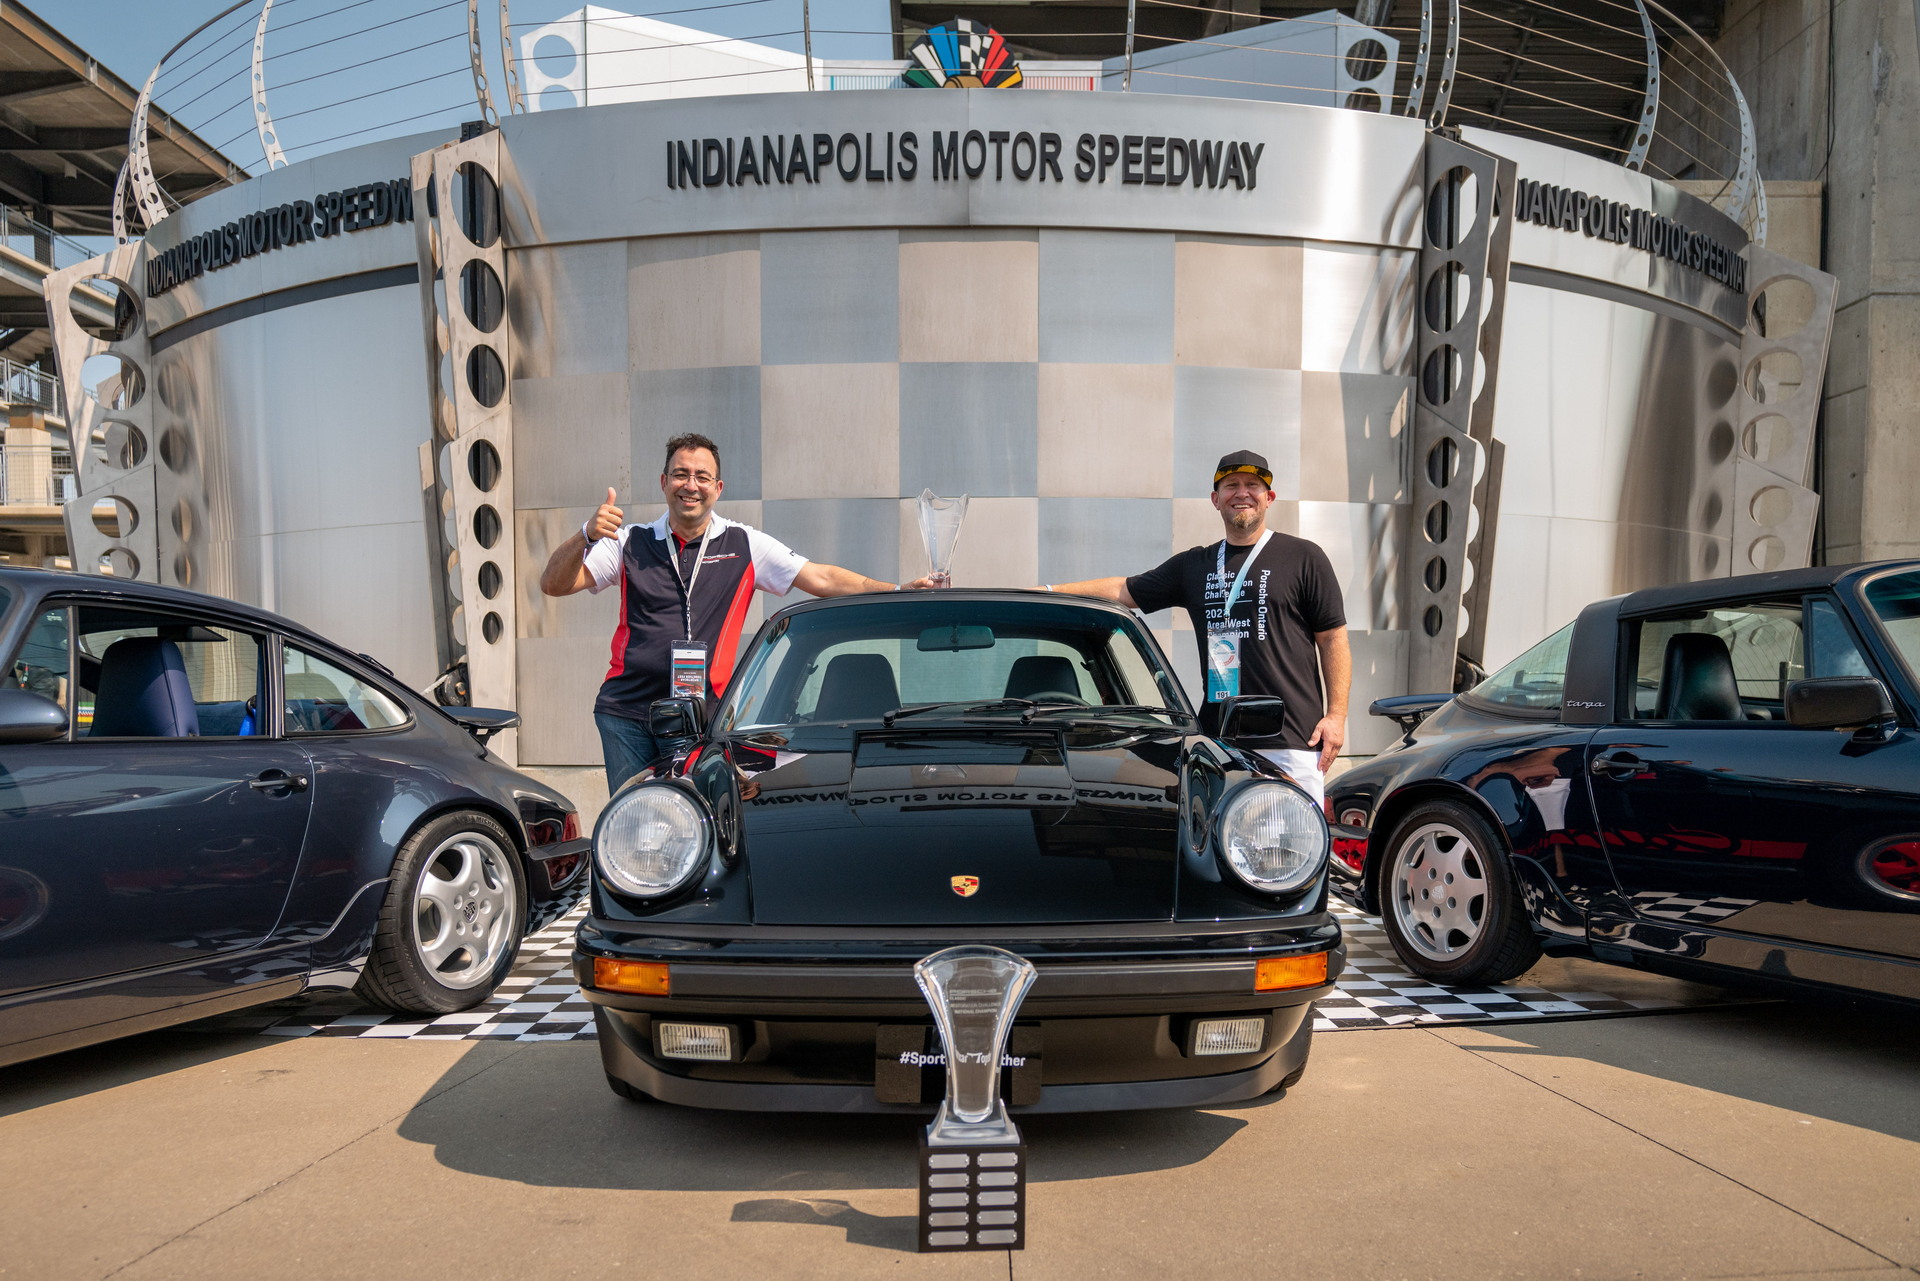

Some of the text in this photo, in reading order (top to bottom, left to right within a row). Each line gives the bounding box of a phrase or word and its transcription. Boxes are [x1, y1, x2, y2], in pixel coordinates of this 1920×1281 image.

[666, 130, 1265, 190] INDIANAPOLIS MOTOR SPEEDWAY
[238, 199, 316, 259] MOTOR
[313, 174, 415, 238] SPEEDW
[1630, 208, 1691, 266] MOTOR
[1690, 232, 1748, 293] SPEEDWAY
[1205, 608, 1225, 619] 202
[1207, 618, 1251, 630] Area West
[1257, 569, 1271, 641] Porsche Ontario
[1566, 700, 1606, 709] targa
